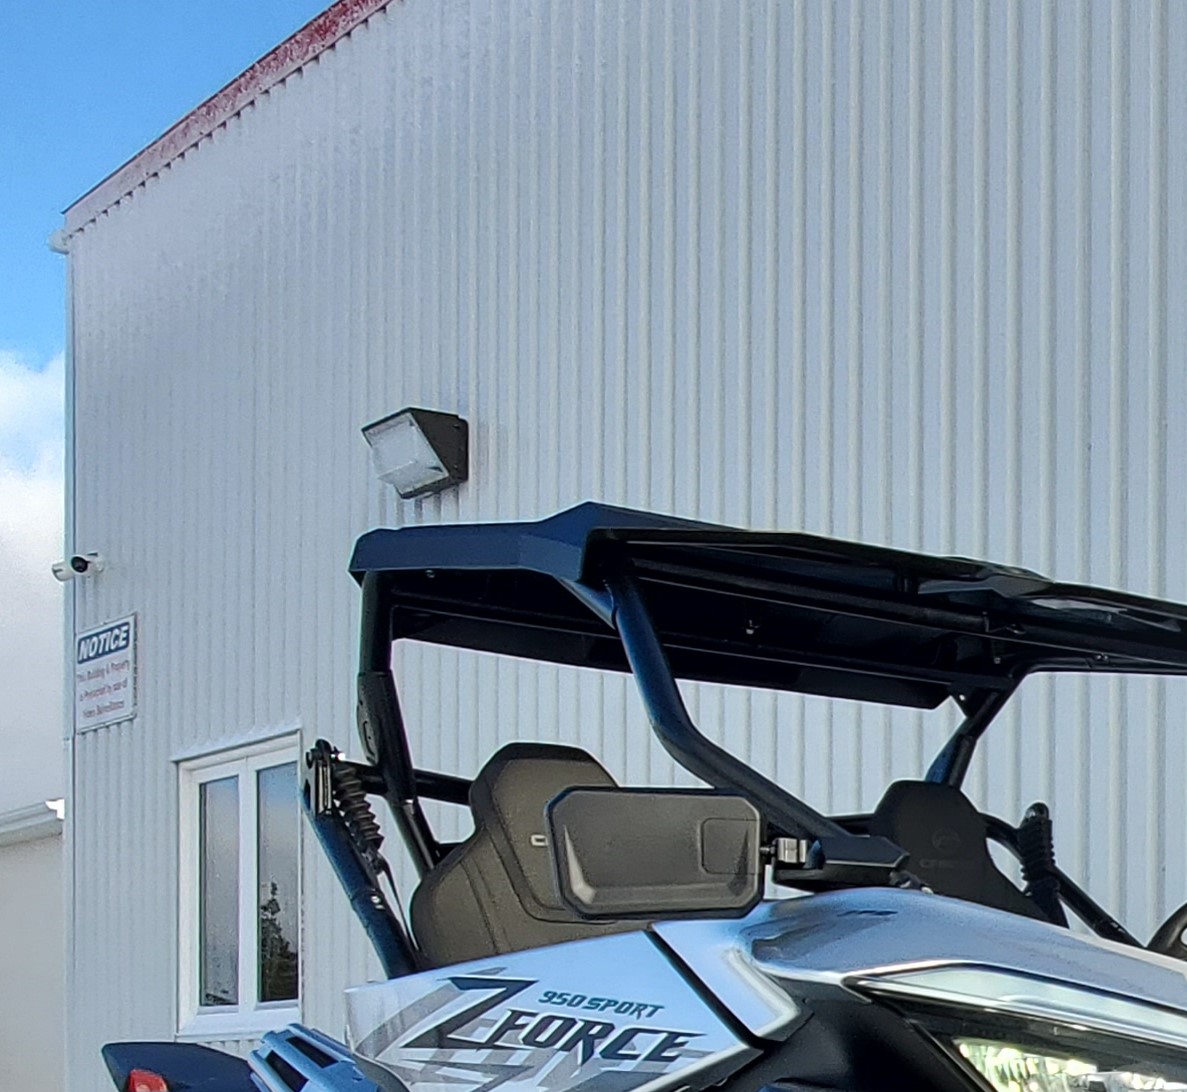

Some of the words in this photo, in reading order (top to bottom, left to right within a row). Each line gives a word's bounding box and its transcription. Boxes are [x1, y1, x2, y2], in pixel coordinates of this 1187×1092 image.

[78, 625, 130, 662] NOTICE
[538, 990, 586, 1007] 950
[581, 997, 665, 1020] SPORT
